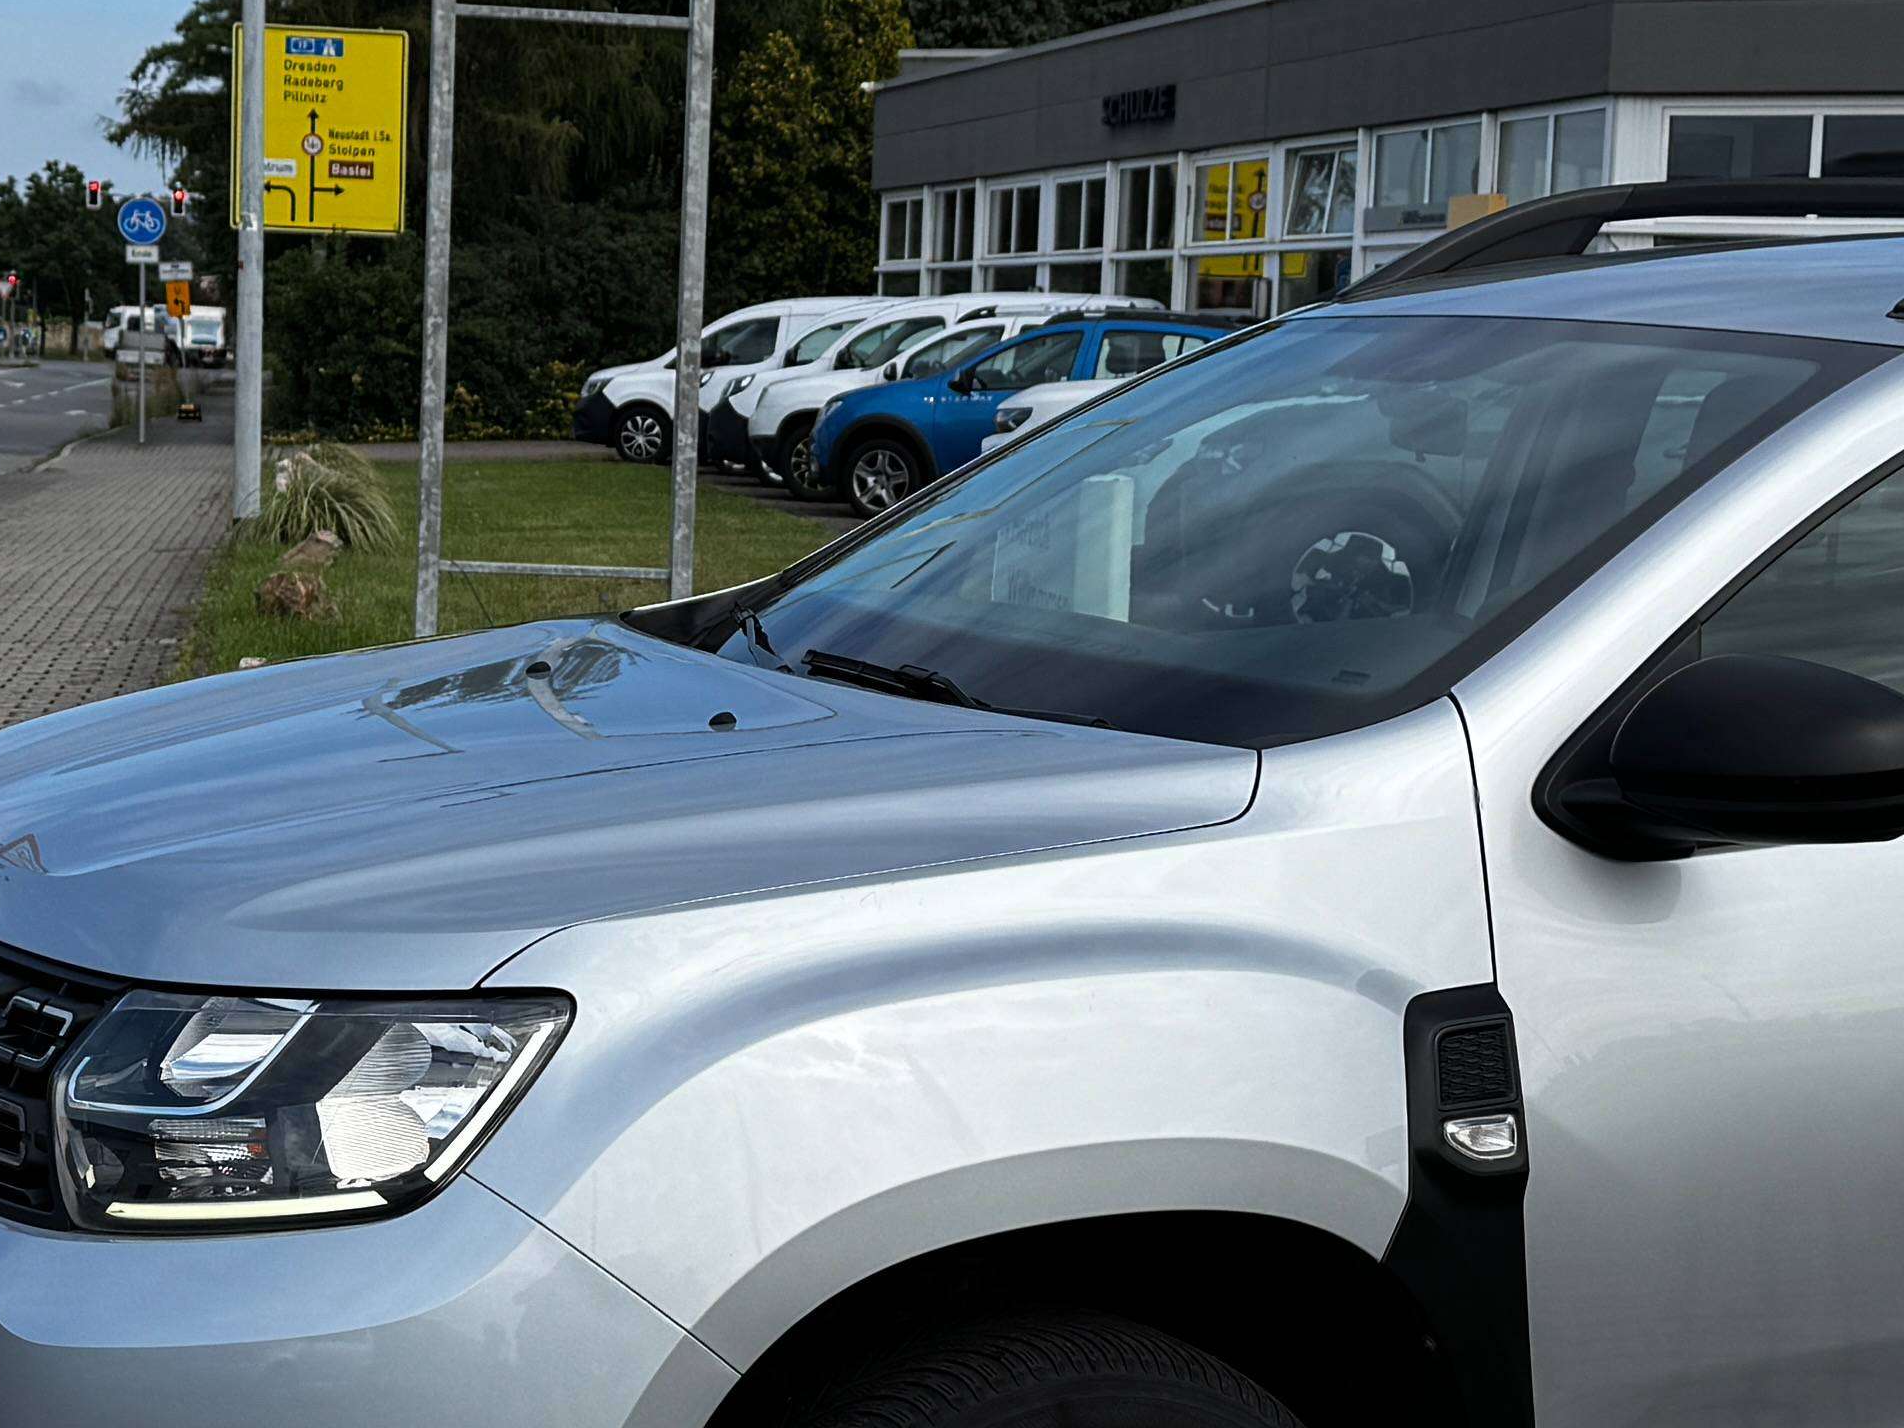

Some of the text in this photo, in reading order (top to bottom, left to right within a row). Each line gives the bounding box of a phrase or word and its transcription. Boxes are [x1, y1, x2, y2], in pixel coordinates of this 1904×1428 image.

[284, 59, 336, 73] Dresden
[284, 75, 344, 91] Radeberg
[284, 90, 327, 103] Pillnitz
[328, 128, 369, 141] Neustadt
[328, 144, 375, 158] Stolpen
[264, 162, 293, 173] trum
[331, 162, 371, 177] Bastei
